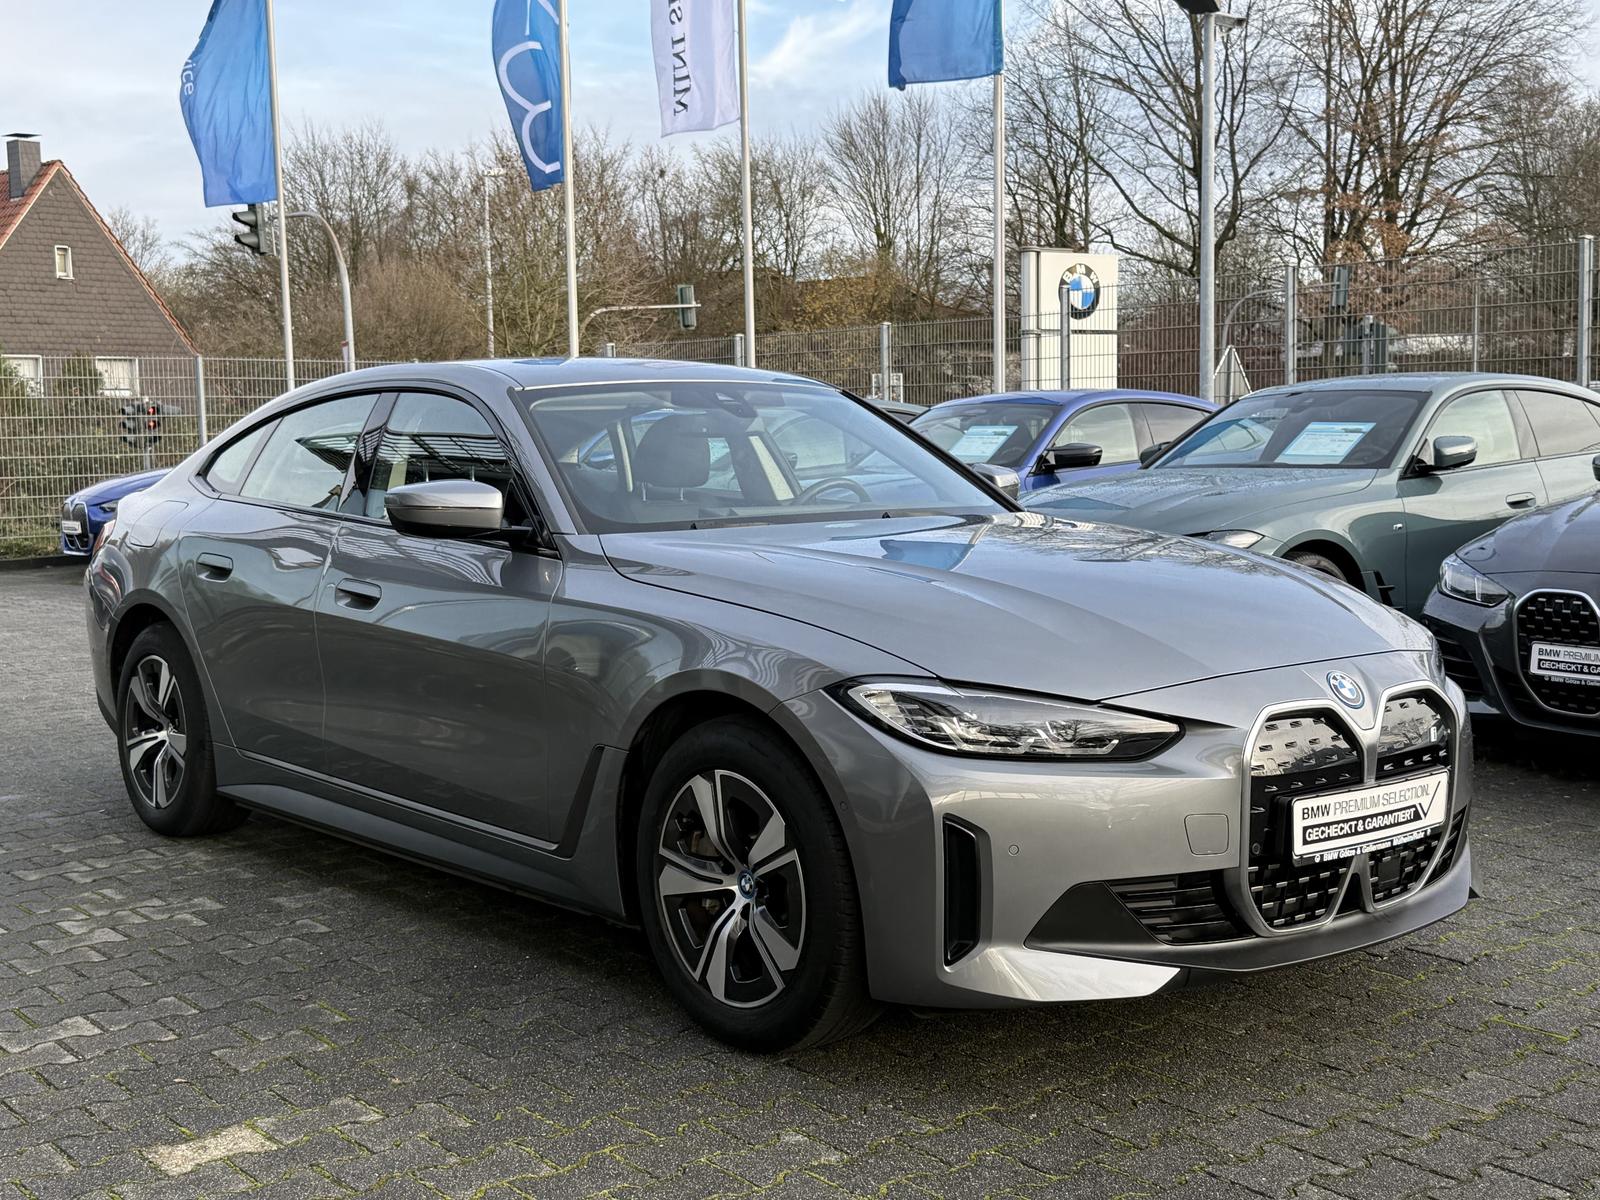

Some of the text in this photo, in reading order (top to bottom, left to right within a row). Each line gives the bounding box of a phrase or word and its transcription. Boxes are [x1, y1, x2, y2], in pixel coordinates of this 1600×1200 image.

[1062, 263, 1100, 284] BMW
[1538, 648, 1561, 658] BMW
[1540, 660, 1583, 672] GECHECKT
[1583, 665, 1589, 673] &
[1302, 803, 1331, 821] BMW
[1333, 796, 1381, 816] PREMIUM
[1305, 807, 1416, 842] GECHECKT & GARANTIERT
